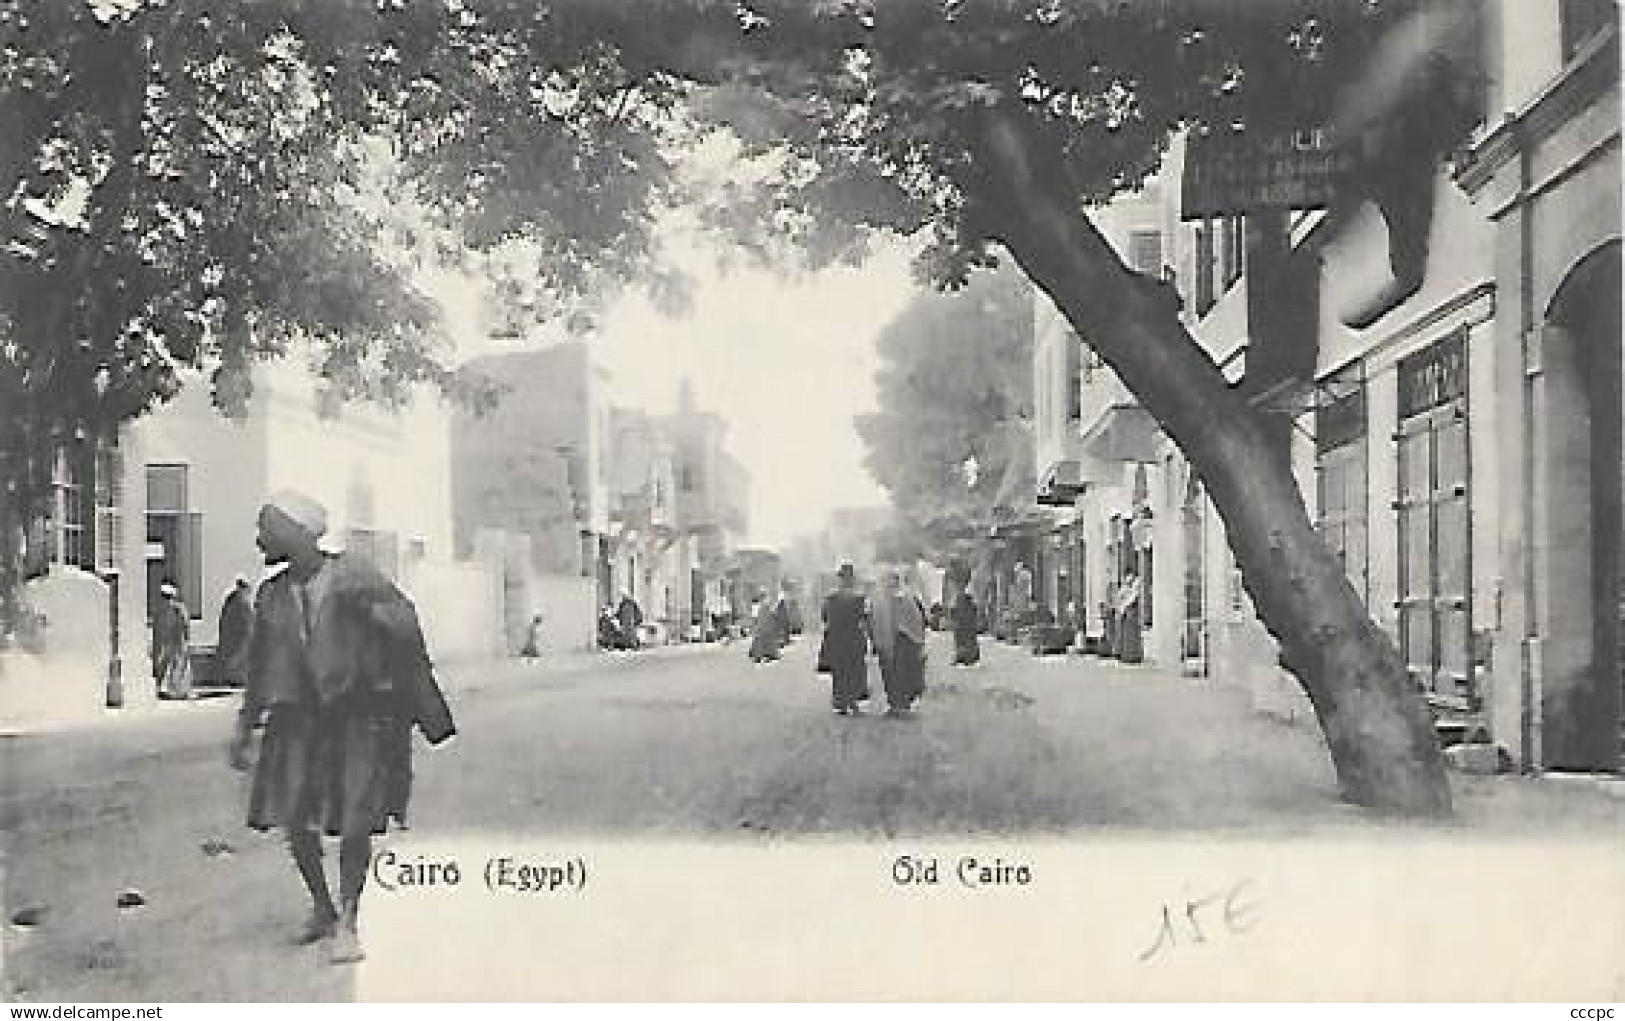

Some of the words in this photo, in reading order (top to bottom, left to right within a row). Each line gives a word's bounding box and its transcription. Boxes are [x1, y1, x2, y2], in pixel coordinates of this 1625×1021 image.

[374, 853, 460, 891] Cairo
[483, 857, 587, 892] (Egypt)
[892, 855, 938, 886] Old
[956, 856, 1033, 888] Cairo
